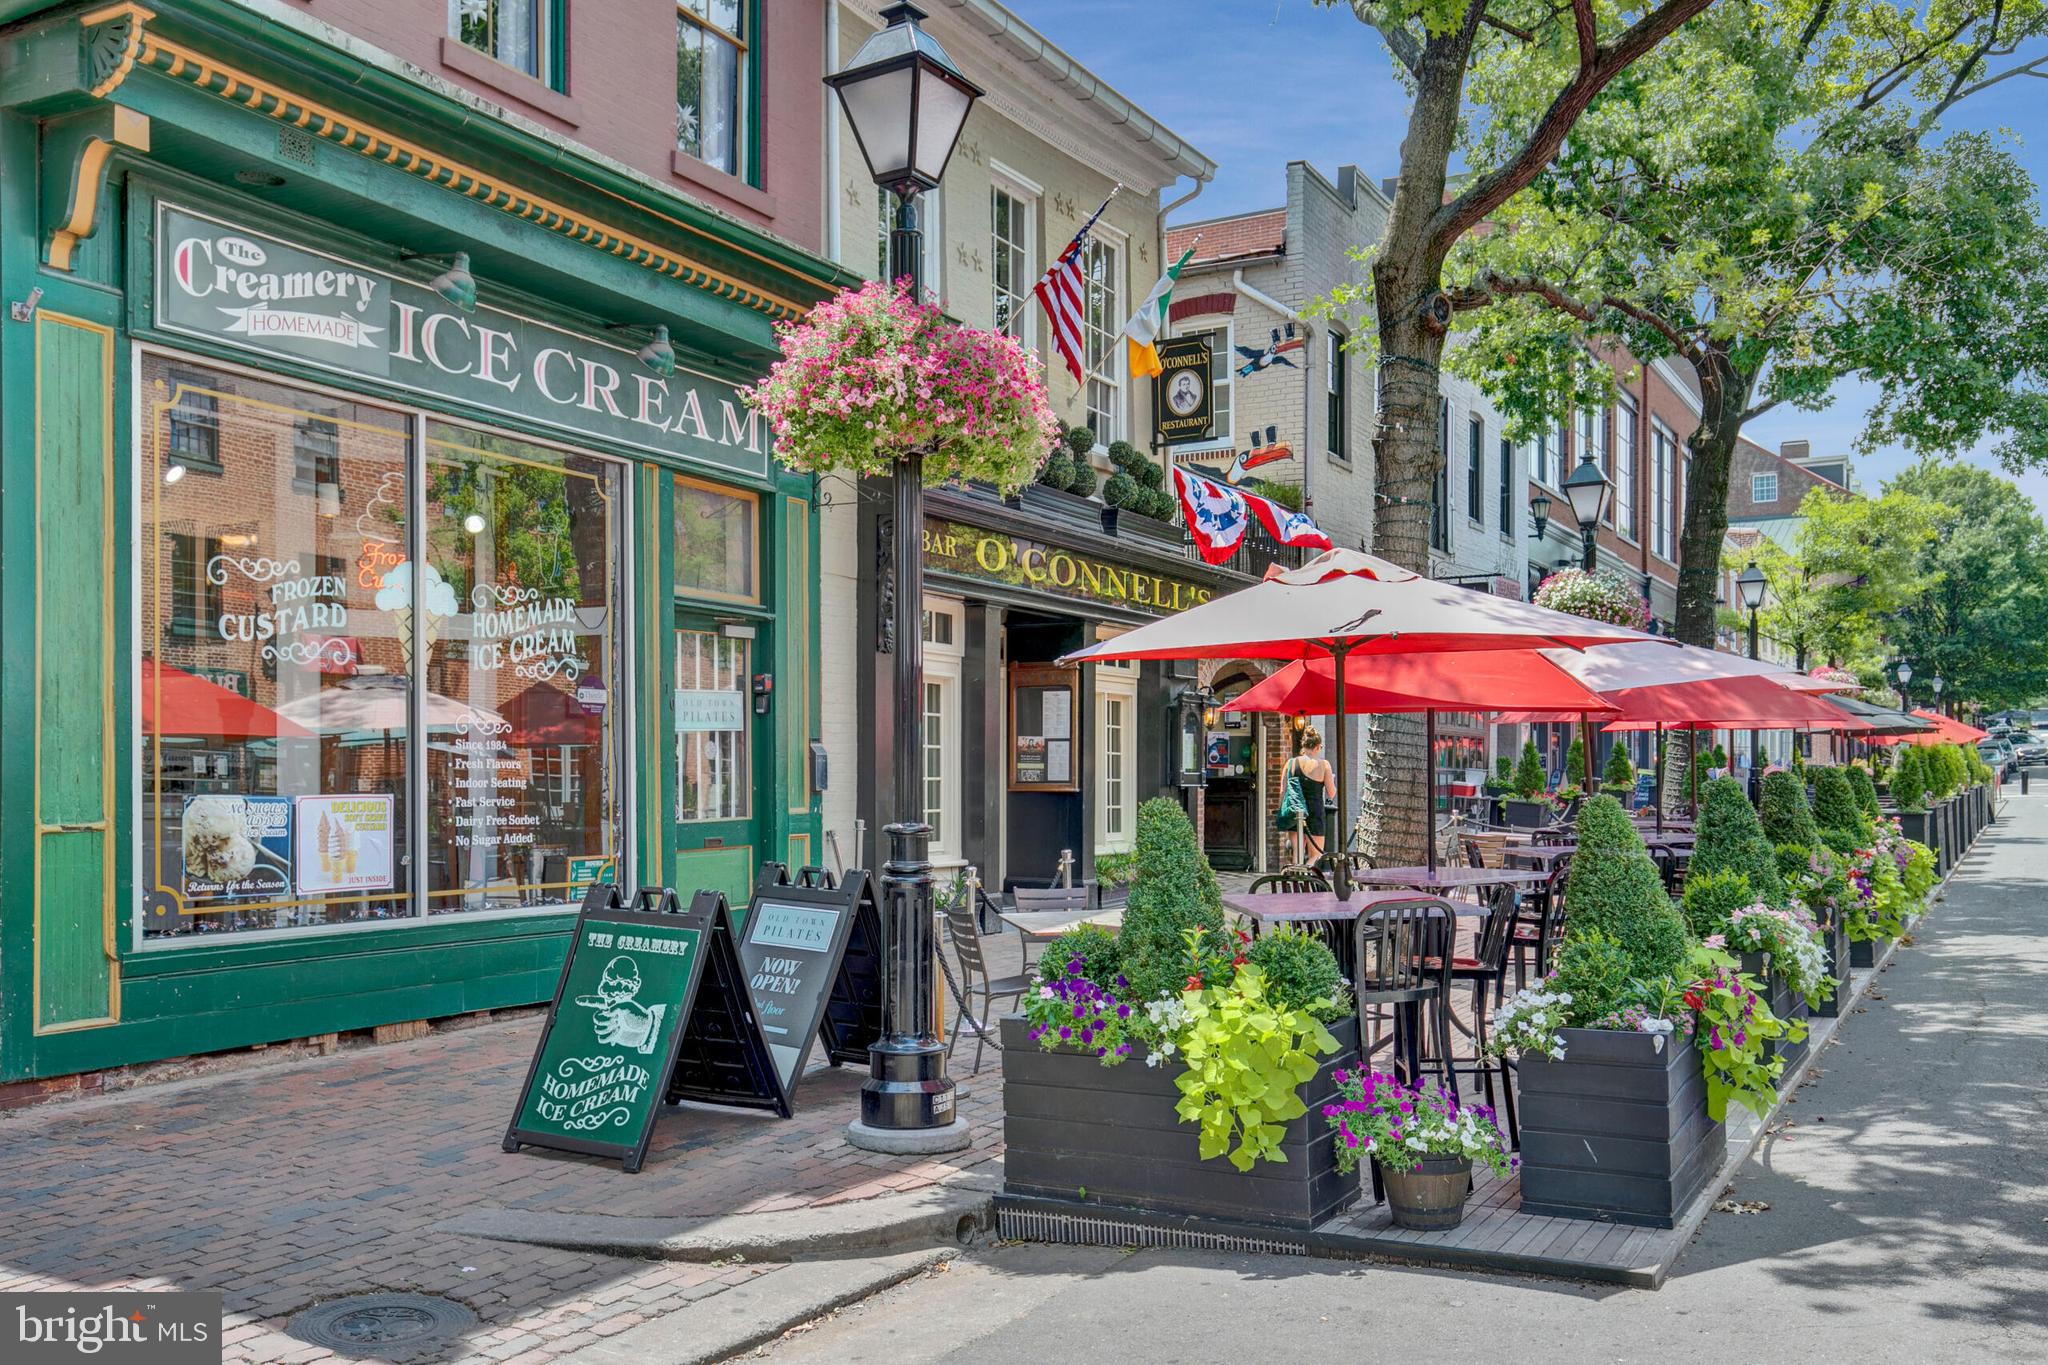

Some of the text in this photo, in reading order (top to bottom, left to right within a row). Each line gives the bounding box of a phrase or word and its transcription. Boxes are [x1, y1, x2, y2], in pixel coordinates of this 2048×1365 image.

[222, 240, 262, 261] The
[173, 237, 377, 312] Creamery
[253, 313, 355, 338] HOMEMADE
[1160, 352, 1208, 369] O'CONNELL'S
[389, 300, 763, 454] ICE CREAM
[1161, 416, 1208, 431] RESTAURANT
[921, 529, 1211, 612] BAR O'CONNELL'S
[271, 575, 347, 605] FROZEN
[218, 602, 348, 642] CUSTARD
[473, 597, 577, 639] HOMEMADE
[471, 628, 577, 671] ICE CREAM
[681, 711, 736, 723] PILATES
[455, 738, 507, 750] Since 1984
[455, 758, 522, 769] Fresh Flavors
[455, 777, 527, 790] Indoor Seating
[331, 800, 387, 813] DELICIOUS
[455, 796, 515, 807] Fast Service
[455, 814, 540, 828] Dairy Free Sorbet
[455, 832, 533, 848] No Sugar Added
[187, 880, 285, 893] Returns for the Season
[763, 924, 823, 942] PILATES
[587, 931, 689, 957] THE CREAMERY
[757, 956, 804, 976] NOW
[750, 974, 802, 995] OPEN!
[761, 1000, 786, 1016] floor
[541, 1063, 650, 1102] HOMEMADE
[536, 1082, 640, 1122] ICE CREAM
